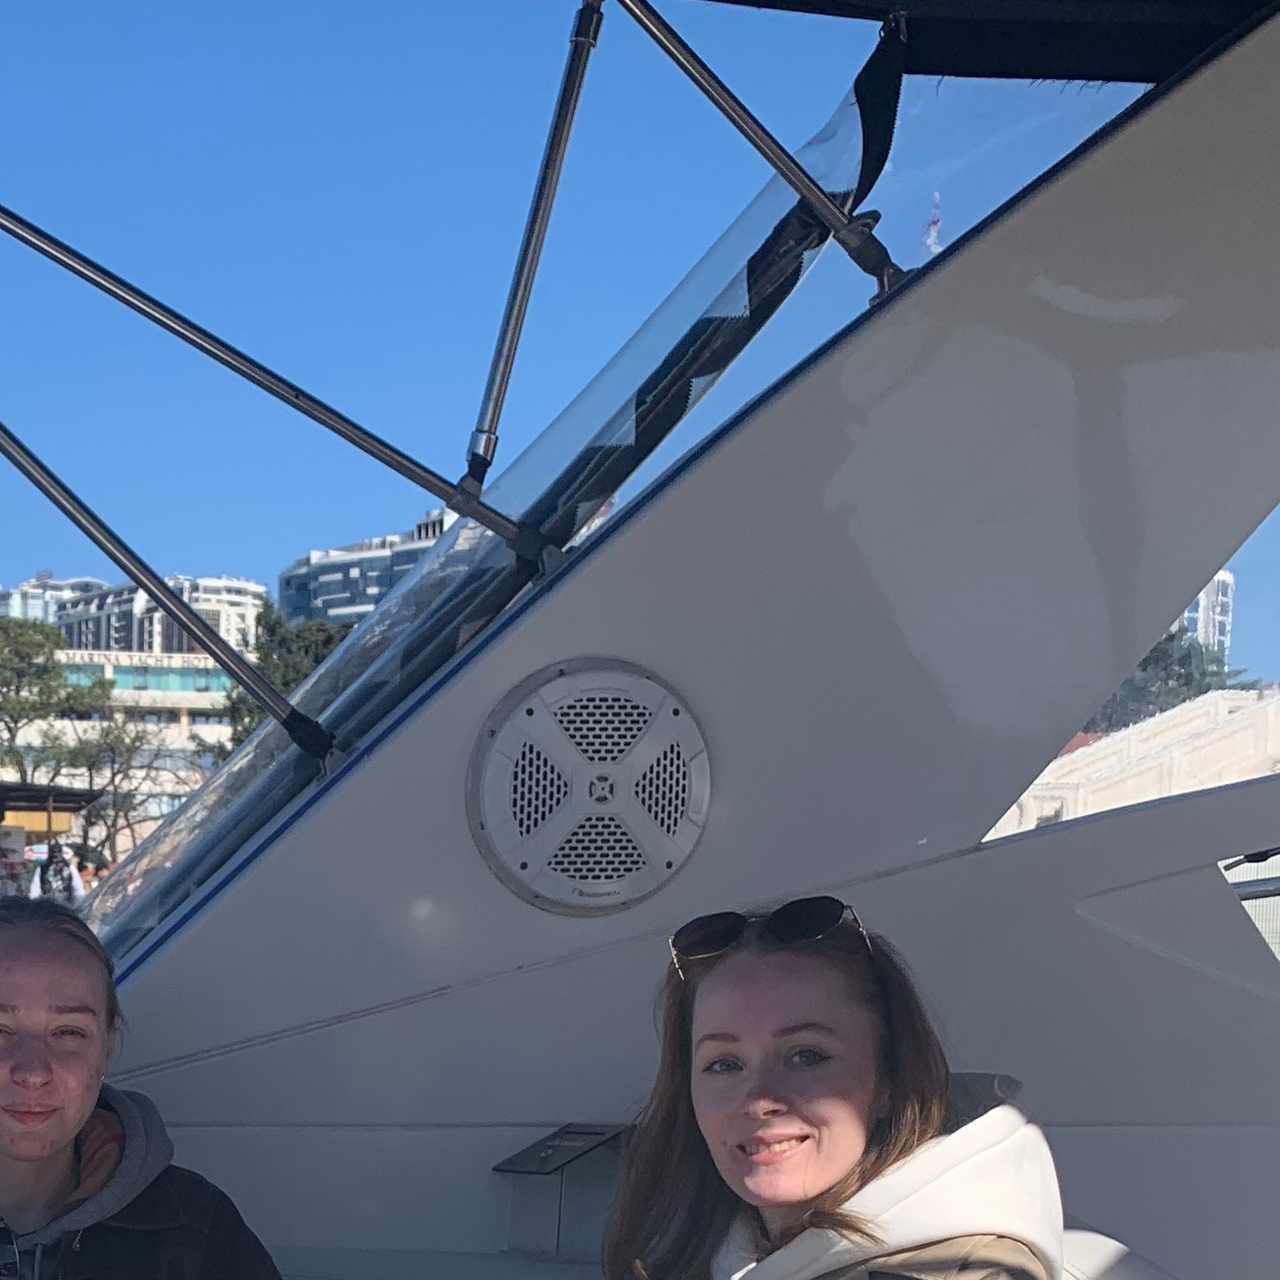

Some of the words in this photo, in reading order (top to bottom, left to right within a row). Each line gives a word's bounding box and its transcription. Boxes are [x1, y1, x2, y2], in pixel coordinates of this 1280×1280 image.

[66, 652, 120, 665] MARINA
[128, 654, 174, 667] YACHT
[181, 656, 217, 669] HOT
